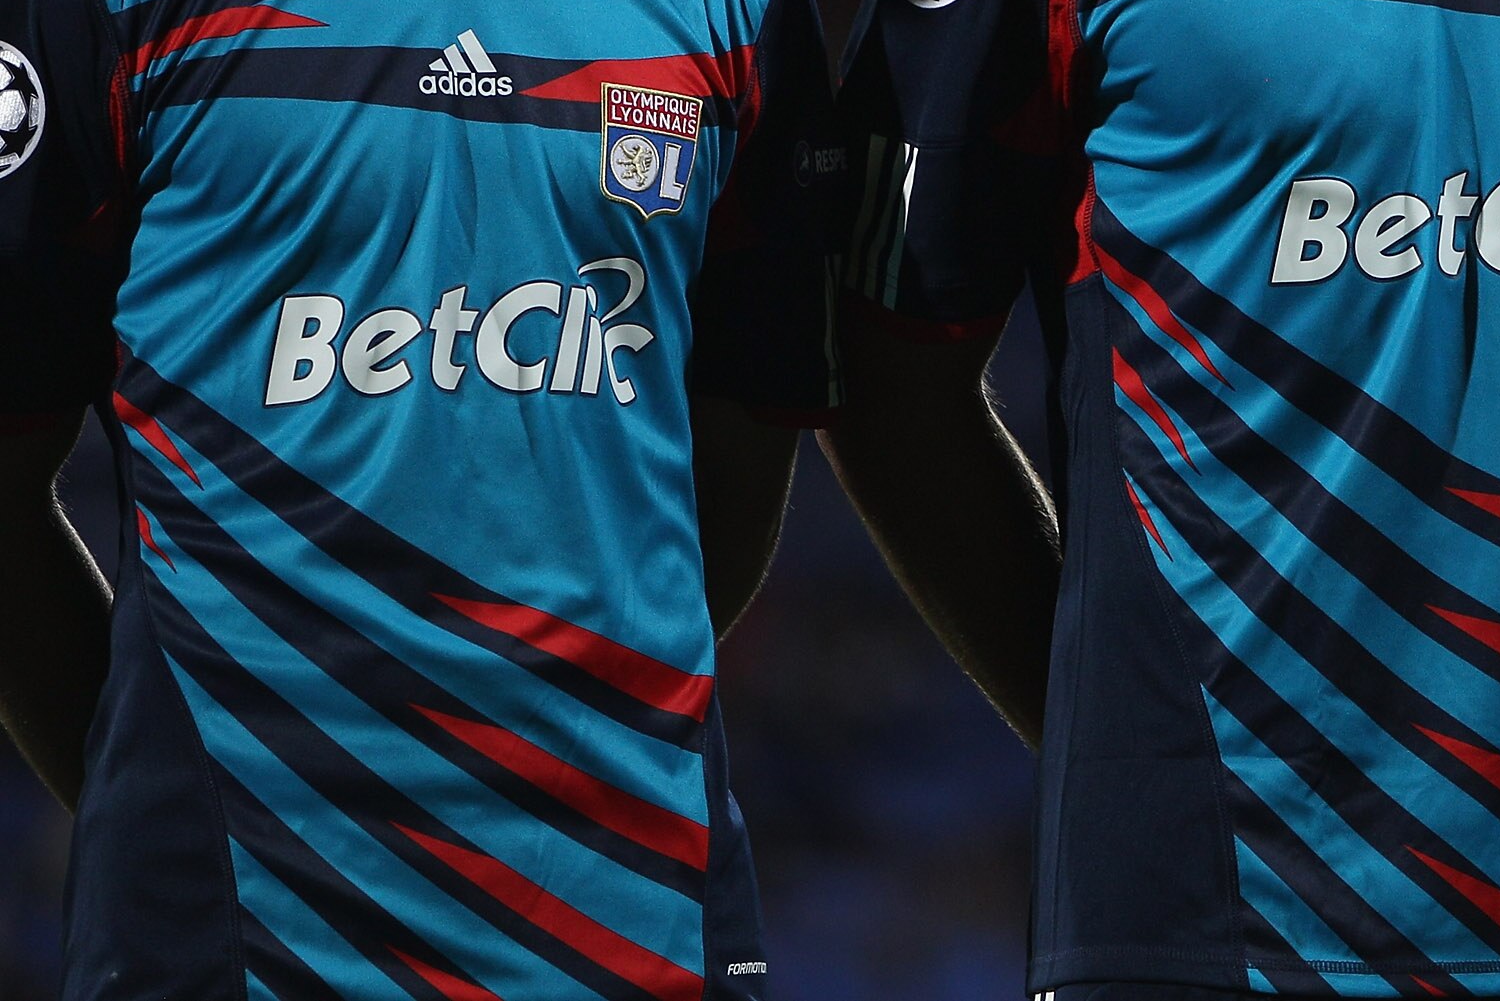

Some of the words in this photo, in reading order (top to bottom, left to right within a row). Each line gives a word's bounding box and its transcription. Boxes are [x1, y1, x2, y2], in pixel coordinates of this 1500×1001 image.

[418, 70, 514, 97] adidas
[610, 89, 698, 118] OLYMPIQUE
[611, 104, 696, 134] LYONNAIS
[265, 282, 655, 405] BetClic
